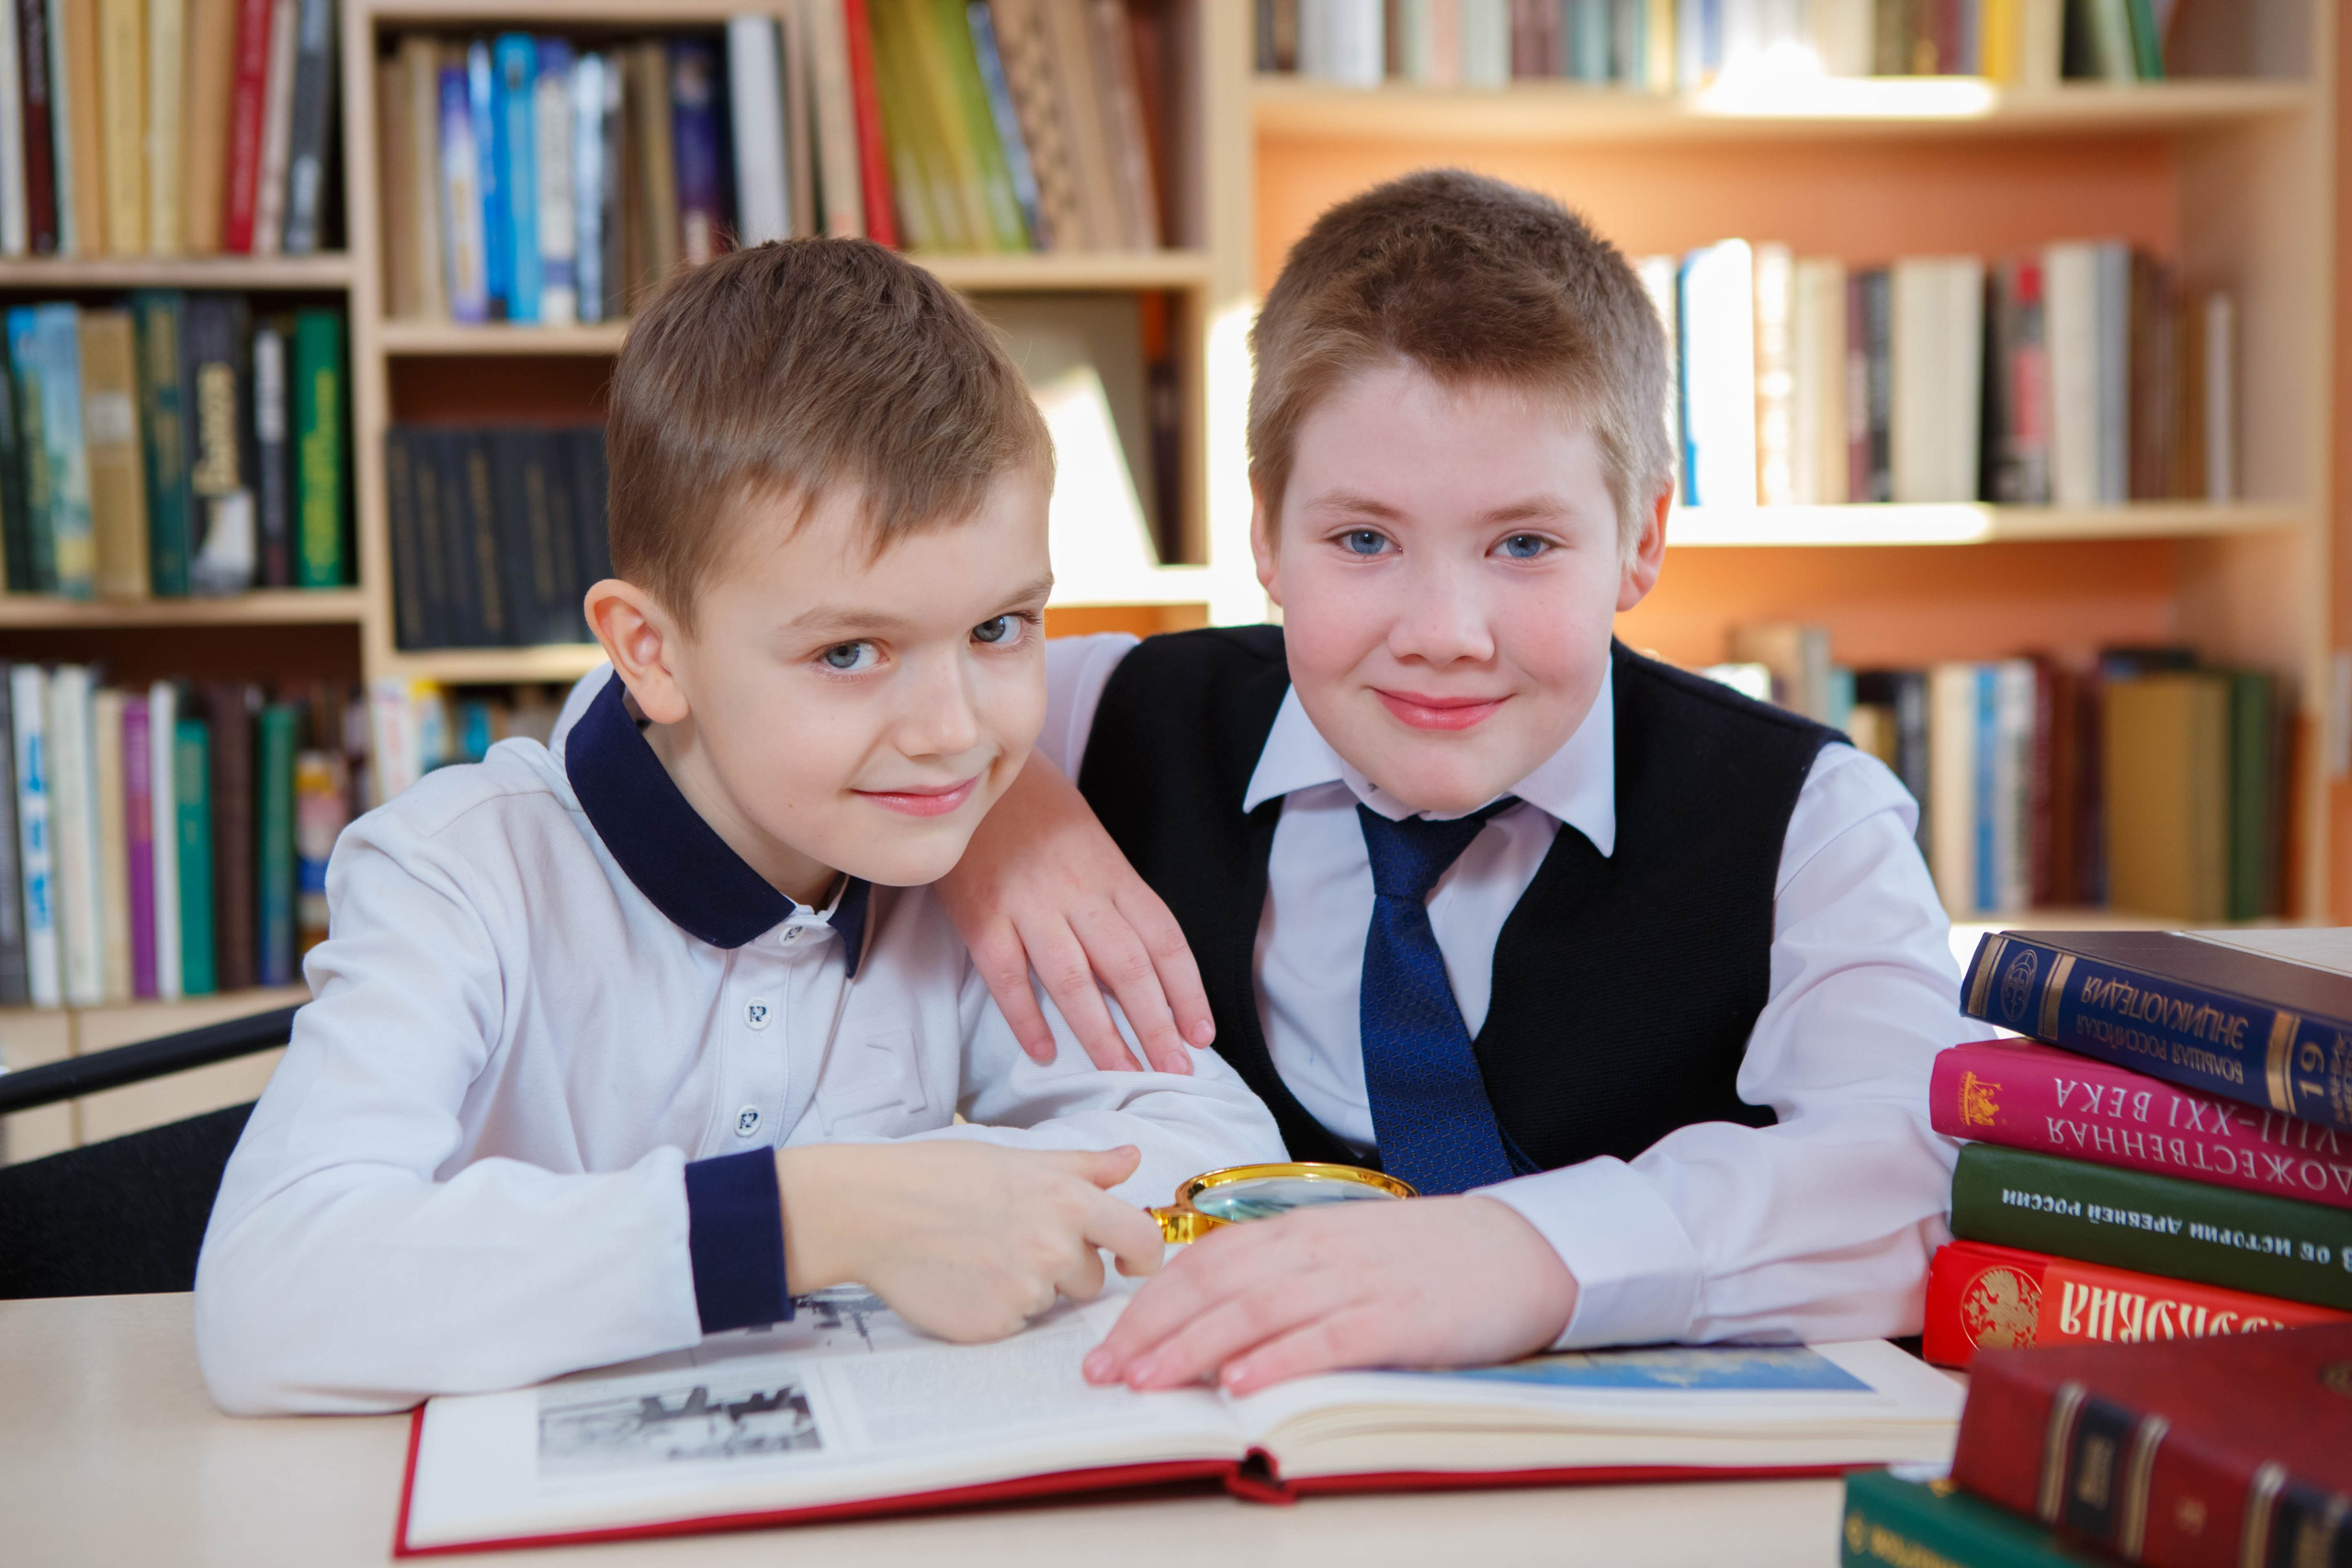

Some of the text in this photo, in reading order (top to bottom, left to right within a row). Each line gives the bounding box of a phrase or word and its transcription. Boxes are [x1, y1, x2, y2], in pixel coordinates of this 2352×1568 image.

[2081, 975, 2249, 1050] ЭНЦИКЛОПЕДИЯ
[2075, 1013, 2245, 1085] БОЛЬШАЯ РОССИЙСКАЯ
[2300, 1051, 2325, 1100] 19
[2052, 1077, 2151, 1122] ВЕКА
[2001, 1187, 2082, 1218] РОССИИ
[2086, 1202, 2184, 1235] ДРЕВНЕЙ
[2188, 1222, 2292, 1258] ИСТОРИИ
[2299, 1242, 2332, 1266] ОБ
